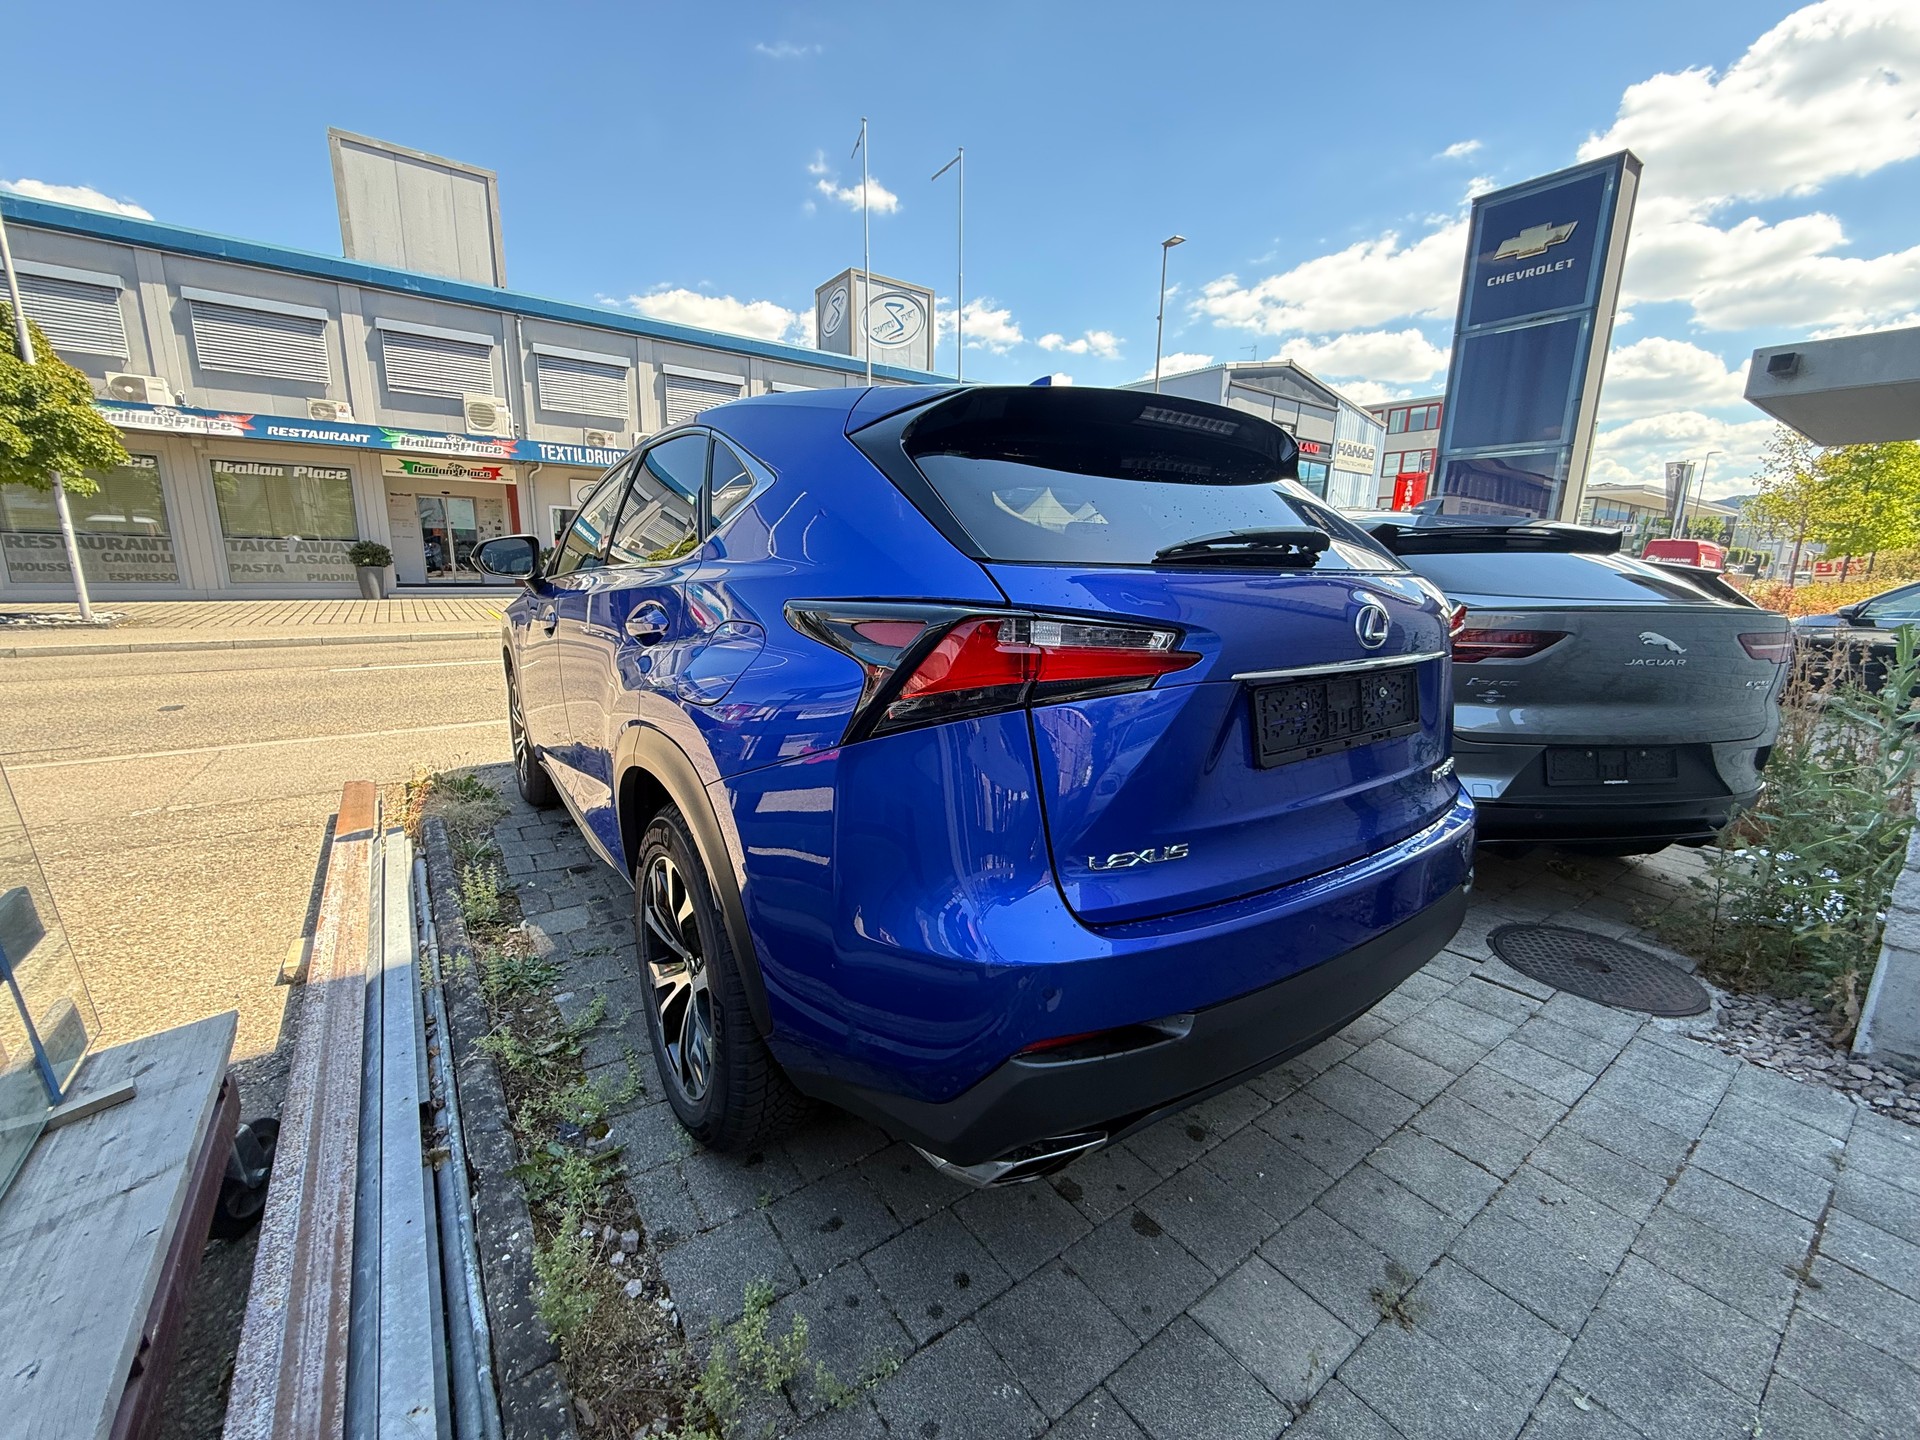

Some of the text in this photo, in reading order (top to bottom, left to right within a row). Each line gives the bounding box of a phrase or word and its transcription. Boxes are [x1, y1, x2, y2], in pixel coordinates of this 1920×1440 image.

[1487, 258, 1575, 287] CHEVROLET
[175, 416, 232, 430] Place
[267, 426, 371, 443] RESTAURANT
[400, 437, 502, 454] Italian Place
[215, 461, 348, 480] Italian Place
[413, 465, 453, 475] Italian
[458, 469, 491, 478] Place
[226, 540, 288, 552] TAKE
[285, 554, 352, 565] LASAGN
[230, 564, 285, 573] PASTA
[109, 573, 178, 581] ESPRESSO
[307, 573, 358, 582] PIADIN
[1088, 843, 1189, 871] LEXUS
